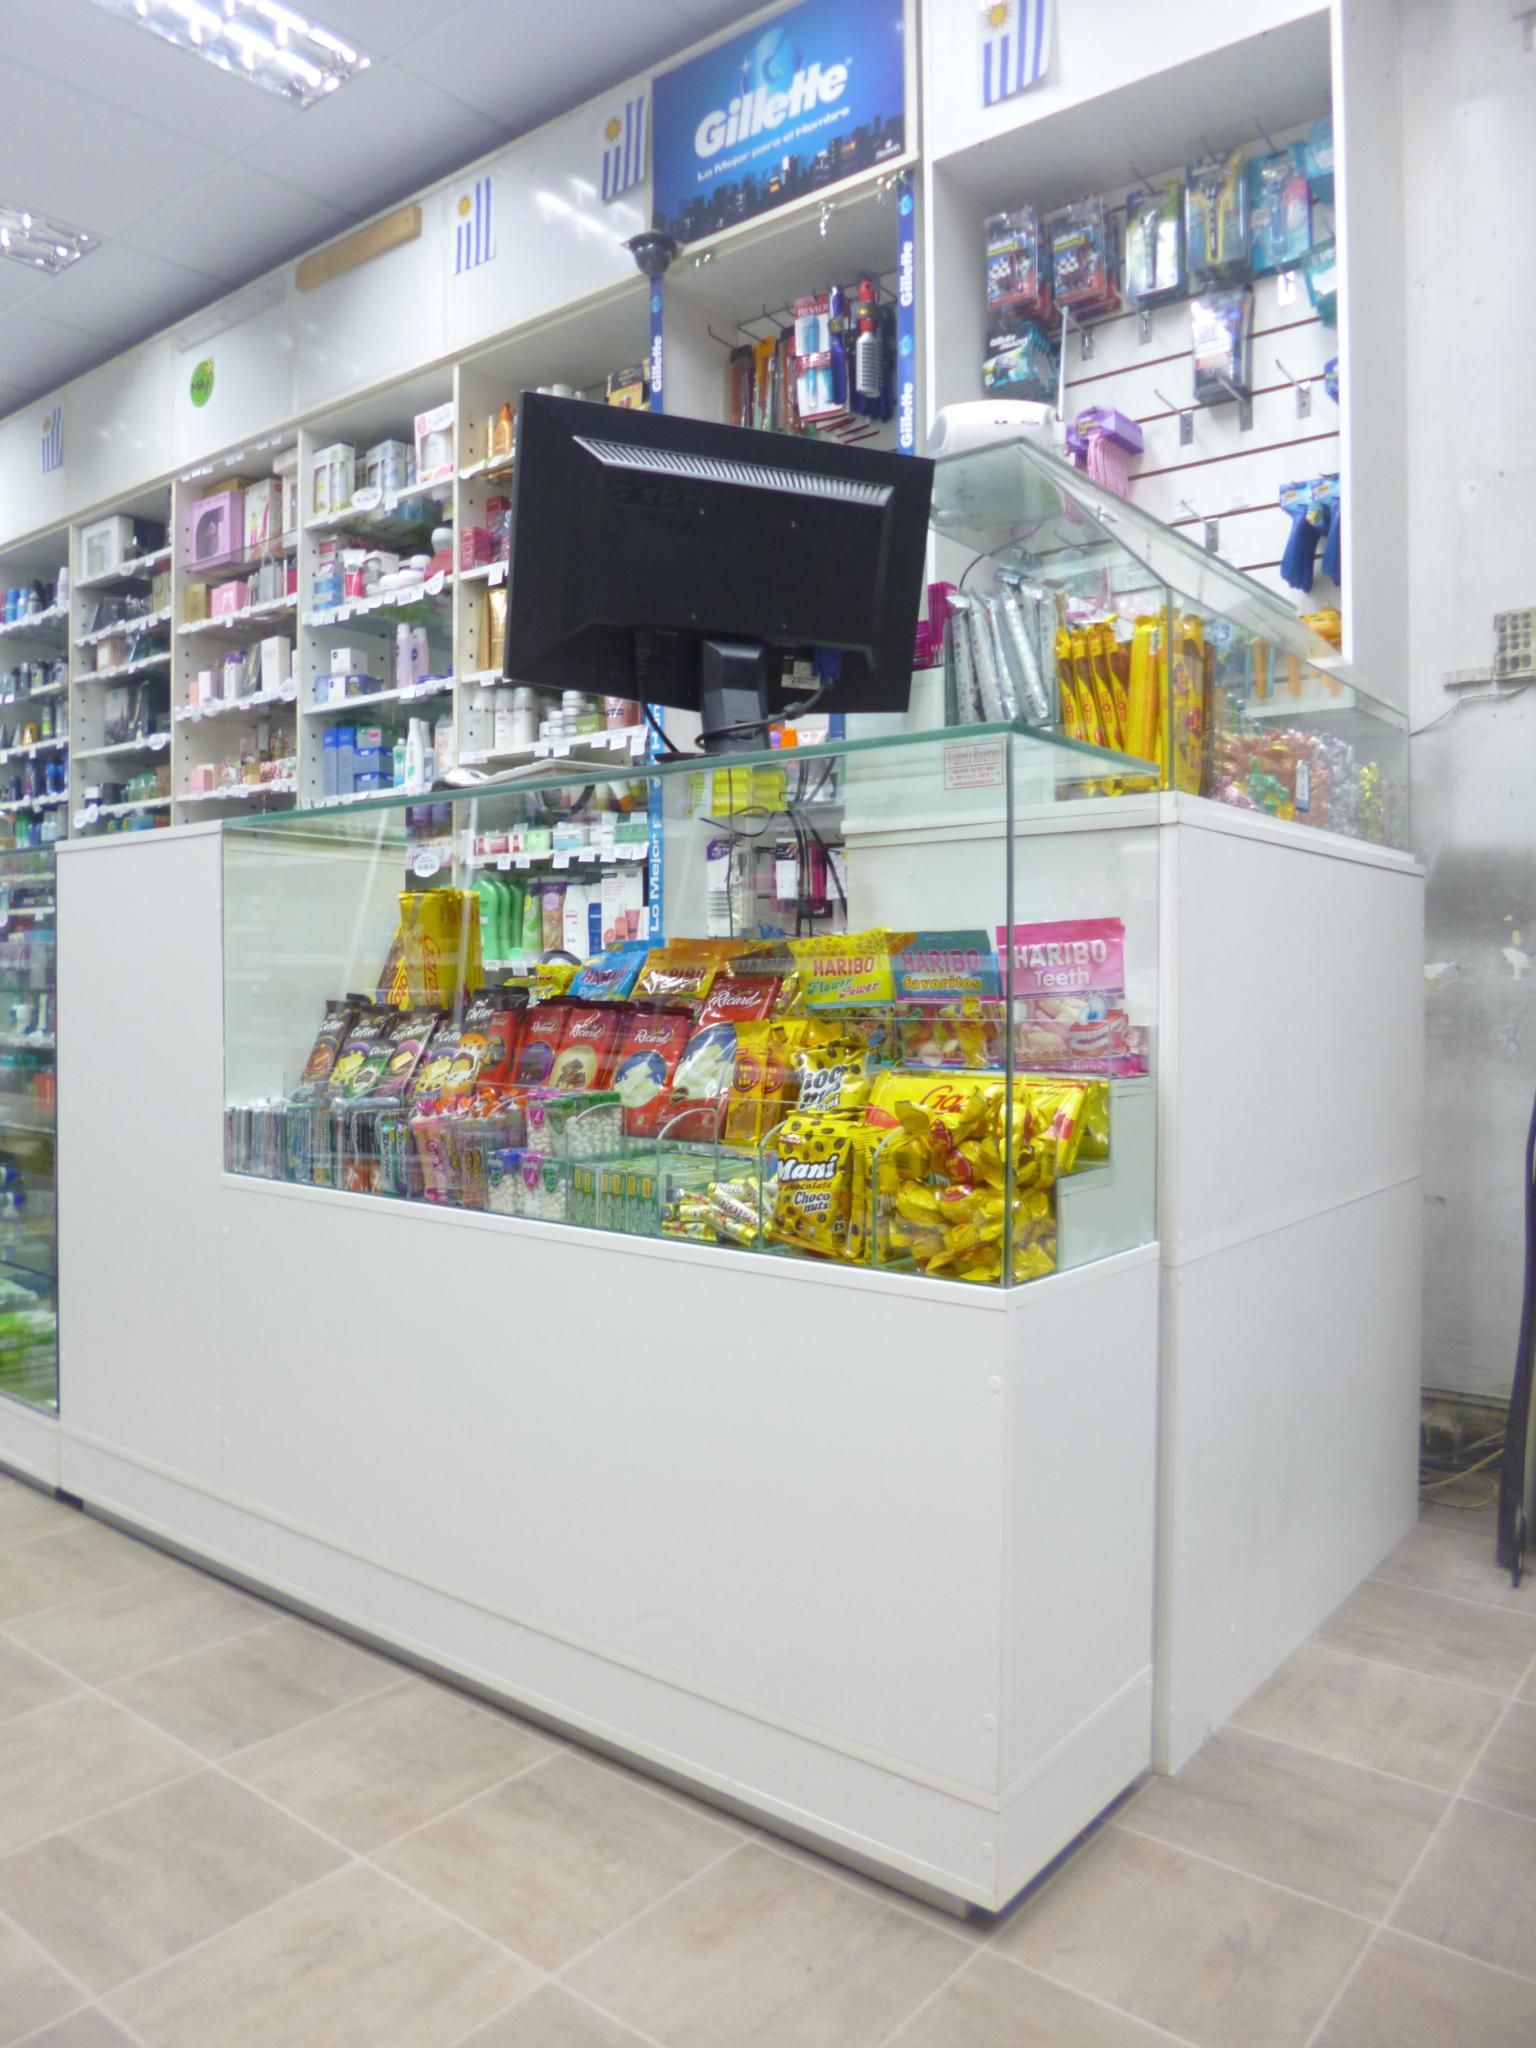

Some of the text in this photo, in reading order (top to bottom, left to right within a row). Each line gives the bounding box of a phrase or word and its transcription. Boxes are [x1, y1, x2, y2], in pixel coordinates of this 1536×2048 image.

[694, 62, 849, 158] Gillette
[714, 151, 749, 174] Mejor
[752, 139, 782, 160] para
[796, 106, 851, 137] Hombre
[901, 241, 914, 306] Gillette
[652, 335, 662, 393] Gillette
[900, 382, 914, 448] Gillette
[650, 833, 662, 900] Mejor
[650, 905, 659, 932] Lo
[813, 956, 875, 977] HARIBO
[901, 949, 980, 973] HARIBO
[1014, 939, 1107, 969] HARIBO
[1033, 967, 1090, 987] Teeth
[712, 991, 761, 1008] Ricard
[569, 1023, 603, 1039] Ricard
[635, 1028, 672, 1045] Ricard
[794, 1191, 831, 1205] Choco
[803, 1201, 829, 1213] nuts
